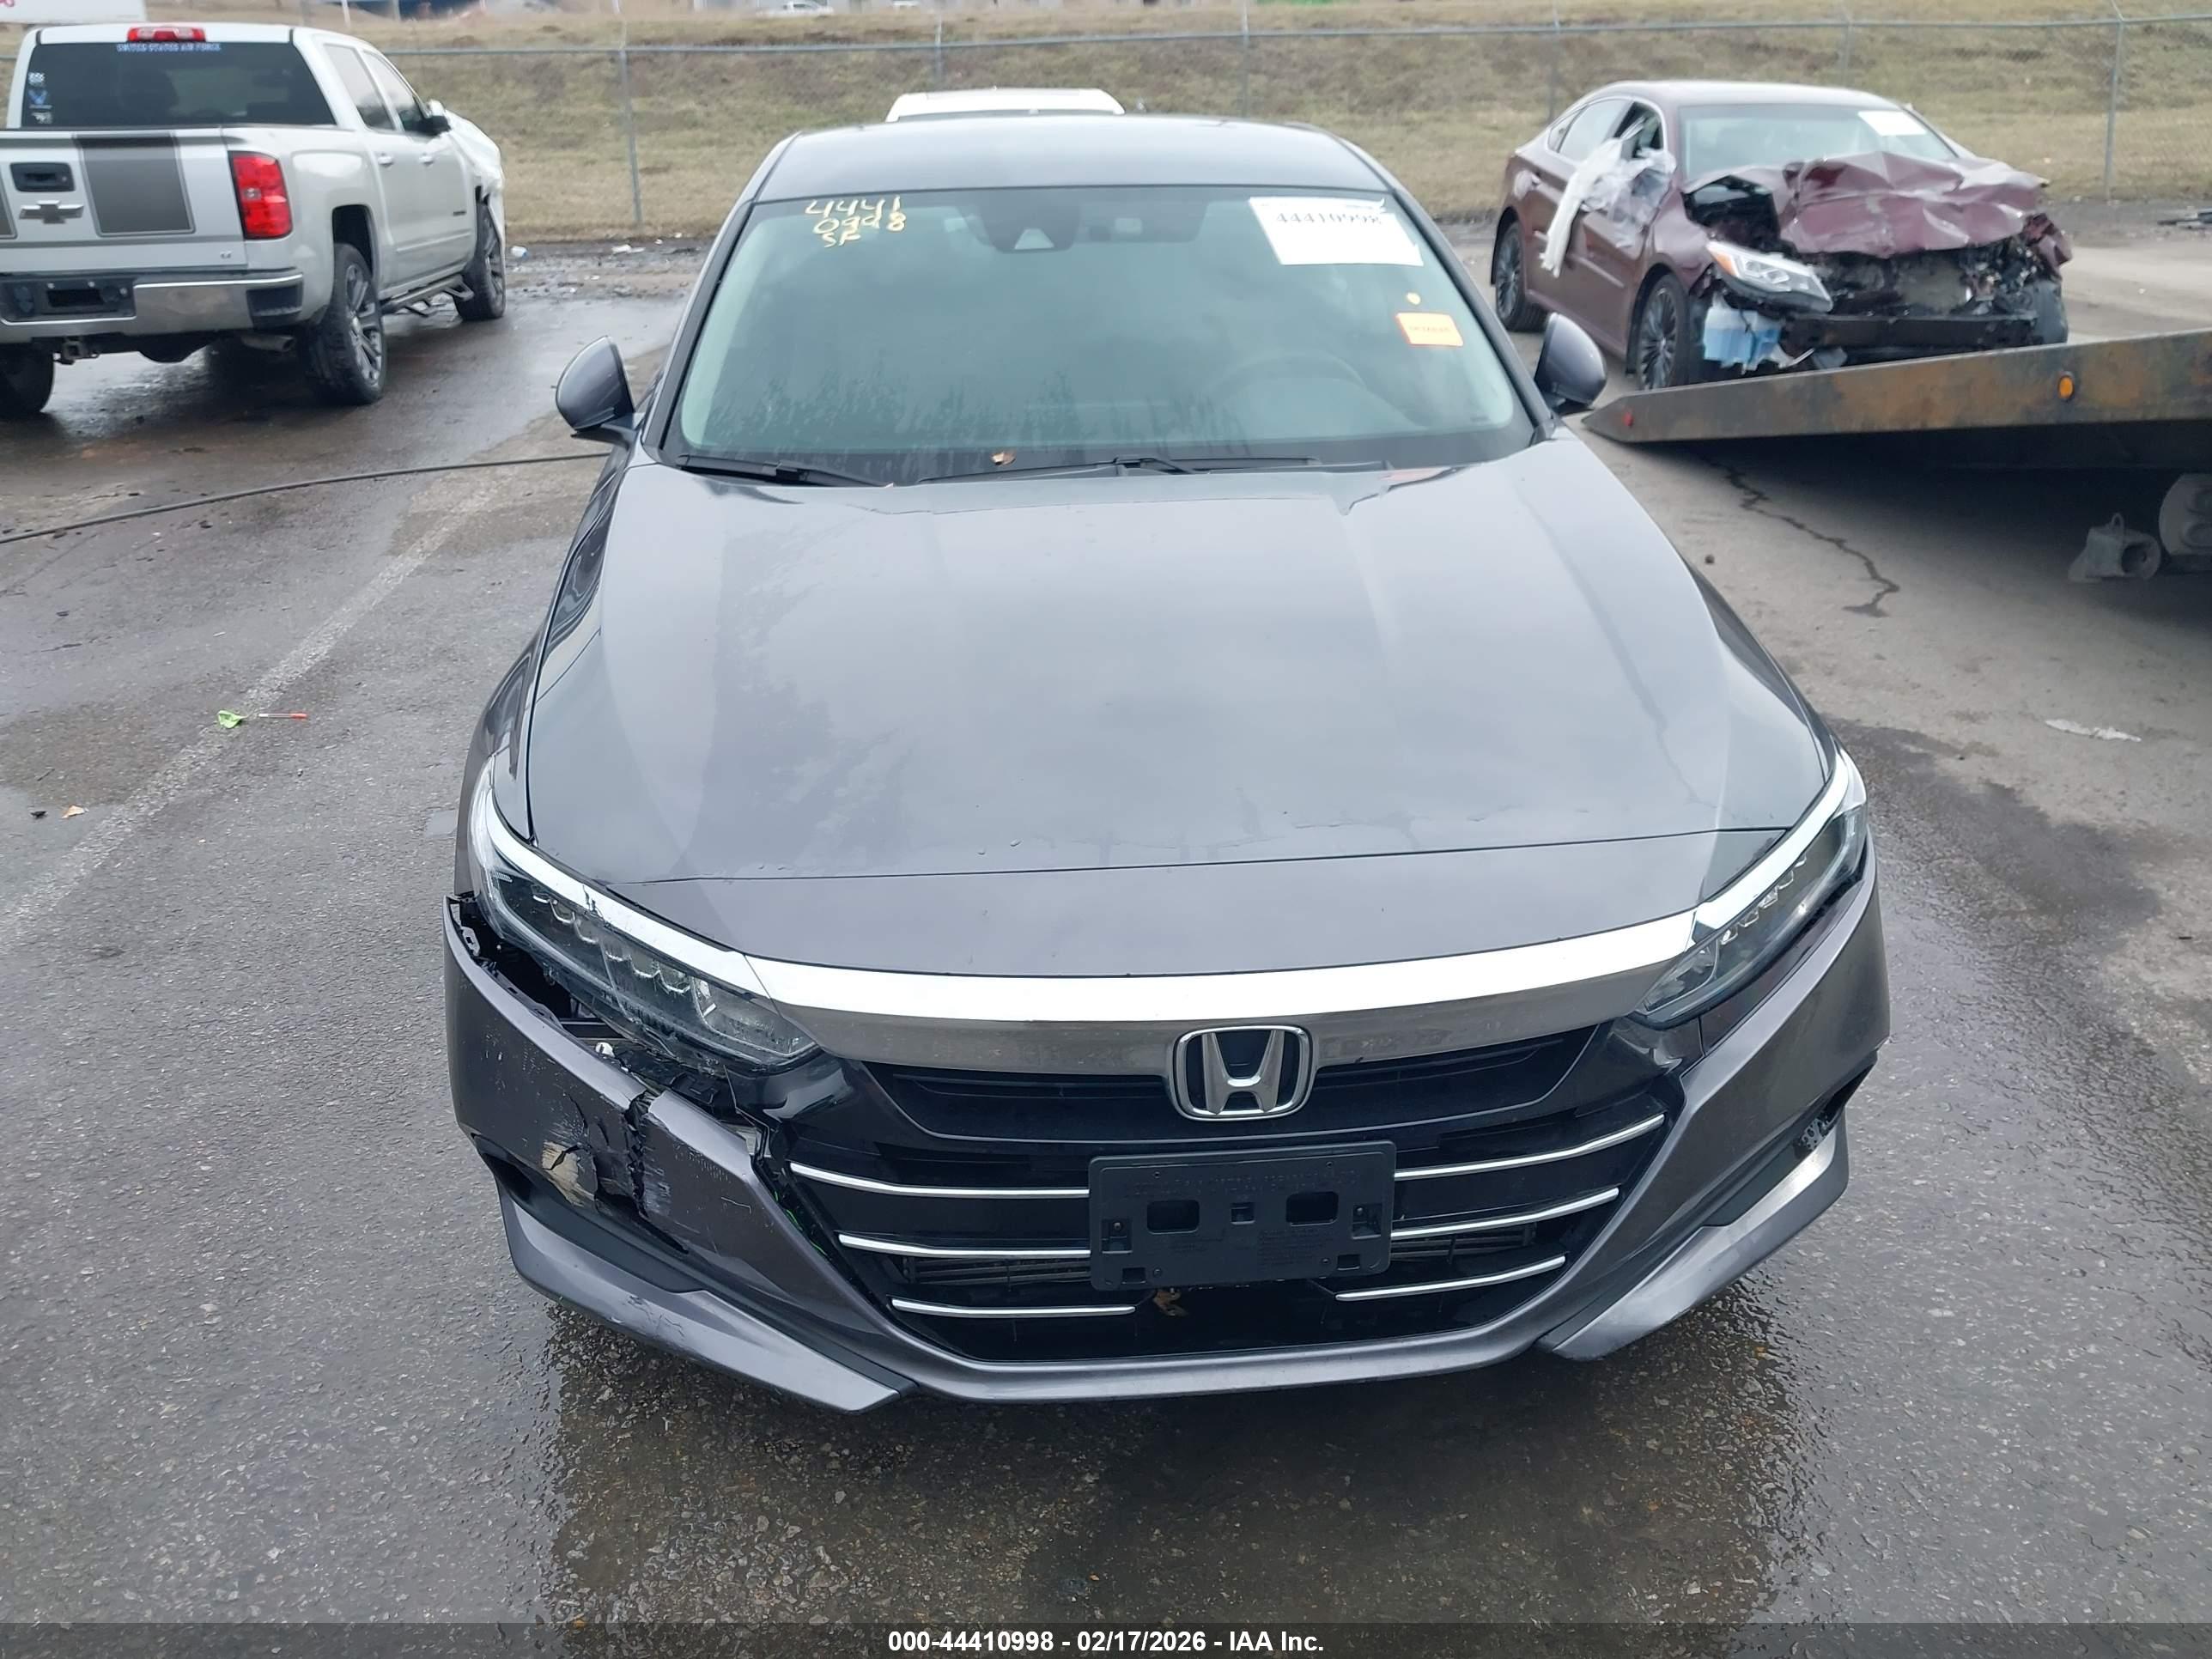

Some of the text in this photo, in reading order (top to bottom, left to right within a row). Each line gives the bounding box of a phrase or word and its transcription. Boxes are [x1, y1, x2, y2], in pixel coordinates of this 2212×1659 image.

[149, 43, 179, 52] STATES
[180, 43, 194, 52] AIR
[194, 43, 222, 52] FORCE
[805, 195, 901, 218] 4441
